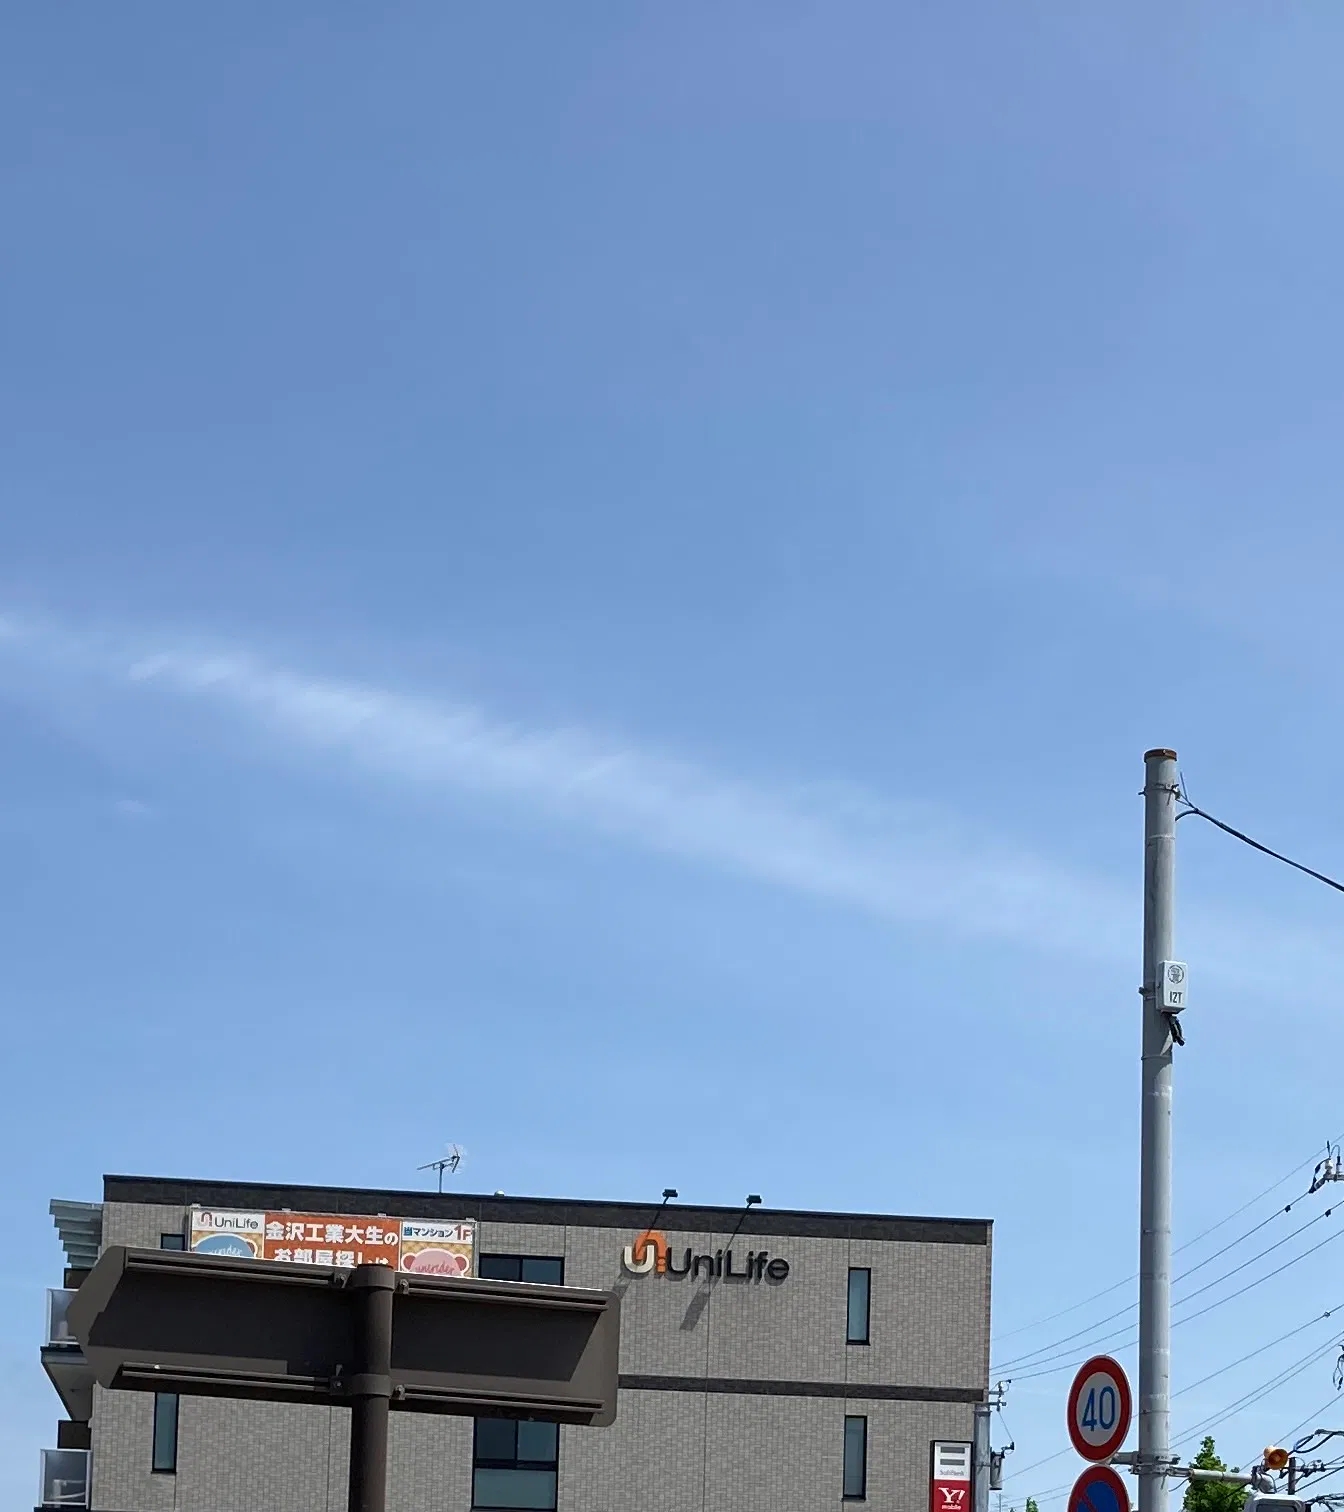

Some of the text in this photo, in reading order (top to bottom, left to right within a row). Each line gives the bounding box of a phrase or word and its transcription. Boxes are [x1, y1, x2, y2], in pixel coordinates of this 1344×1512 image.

[214, 1216, 259, 1230] UniLife
[265, 1220, 399, 1246] 金沢工業大生の
[666, 1247, 790, 1280] UniLife
[1081, 1385, 1116, 1432] 40
[938, 1487, 966, 1504] Y!
